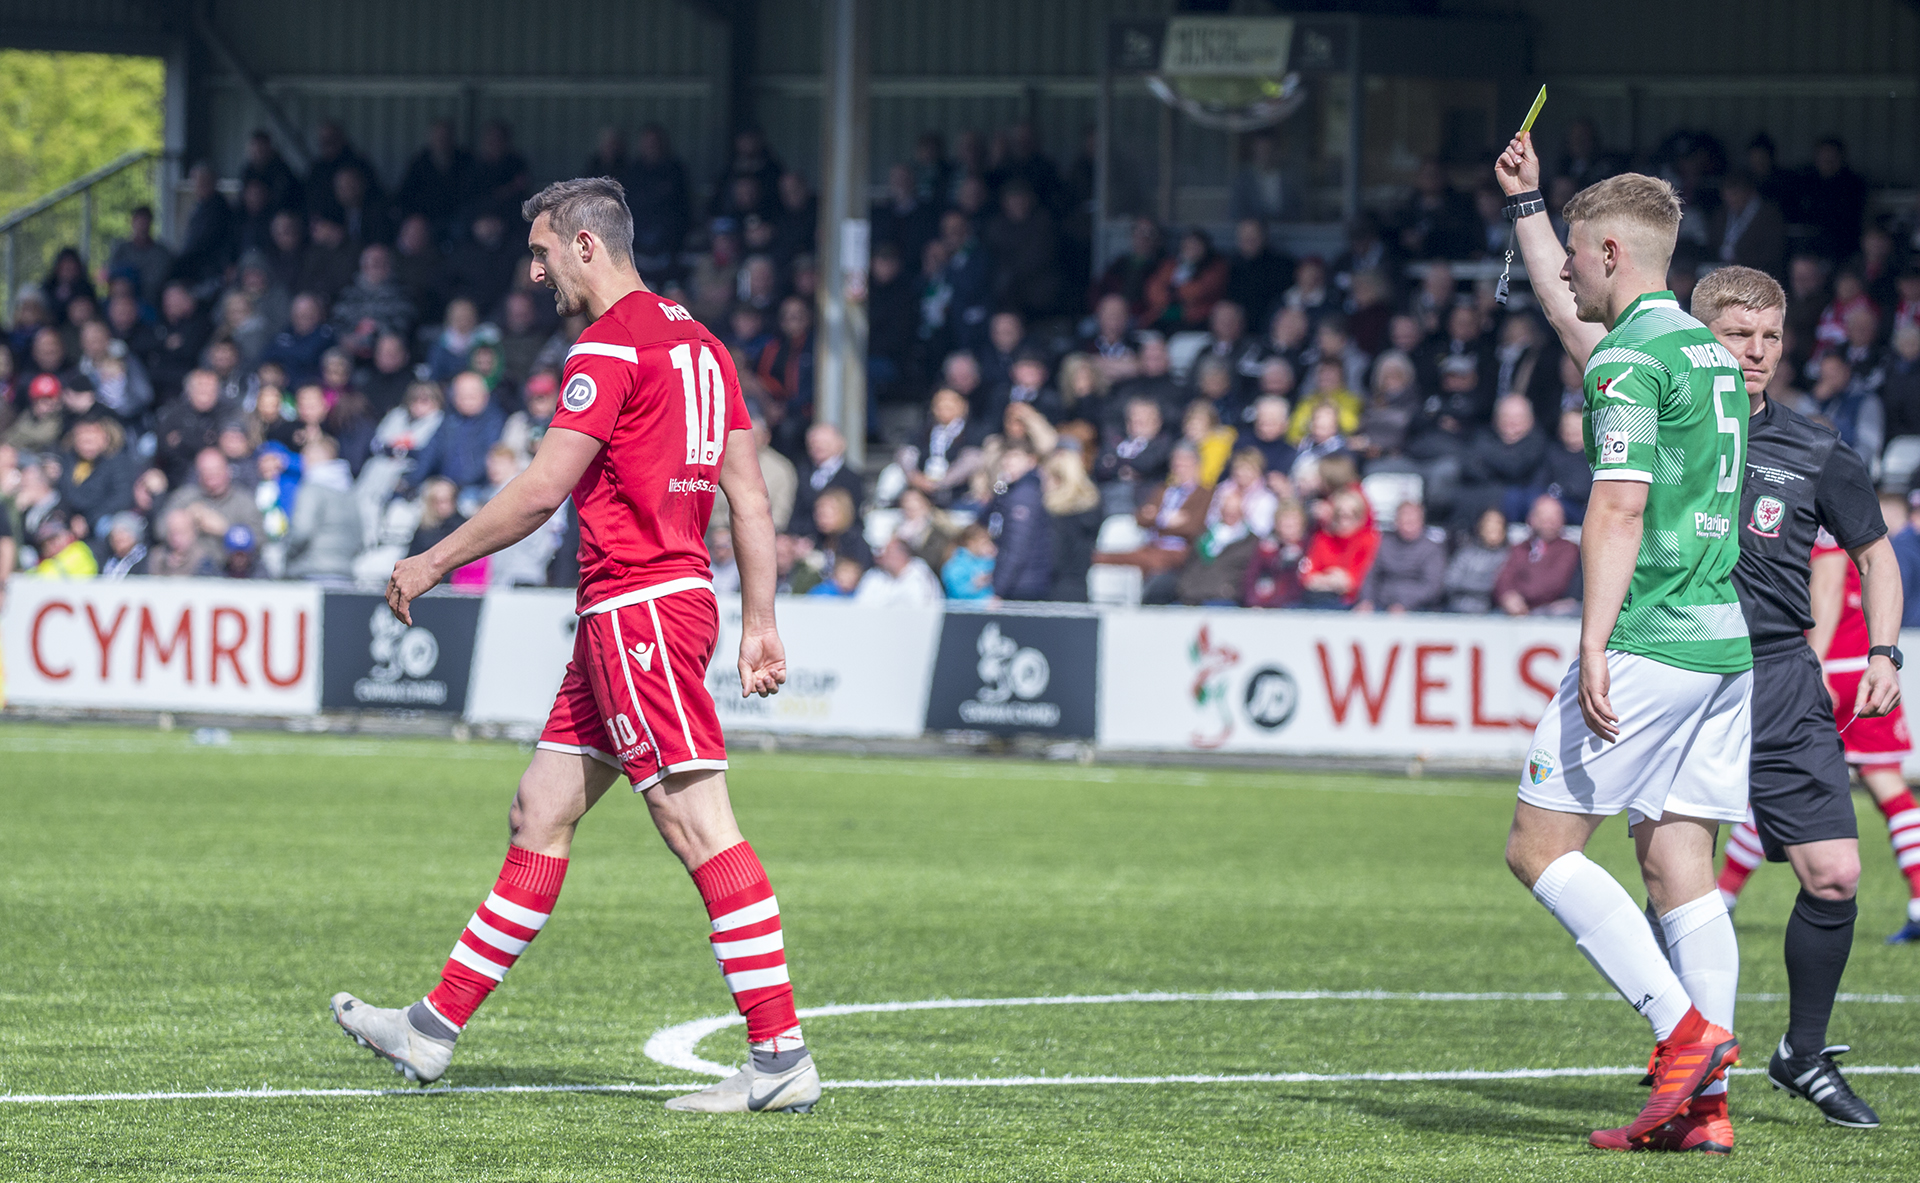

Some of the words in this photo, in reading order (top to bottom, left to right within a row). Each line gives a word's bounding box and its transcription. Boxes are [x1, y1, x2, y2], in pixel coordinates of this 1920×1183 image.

[568, 384, 589, 400] JD
[668, 343, 726, 466] 10
[1713, 375, 1741, 493] 5
[30, 599, 307, 688] CYMRU
[1315, 641, 1579, 731] WELS
[606, 713, 637, 750] 10
[1535, 754, 1550, 764] Saints
